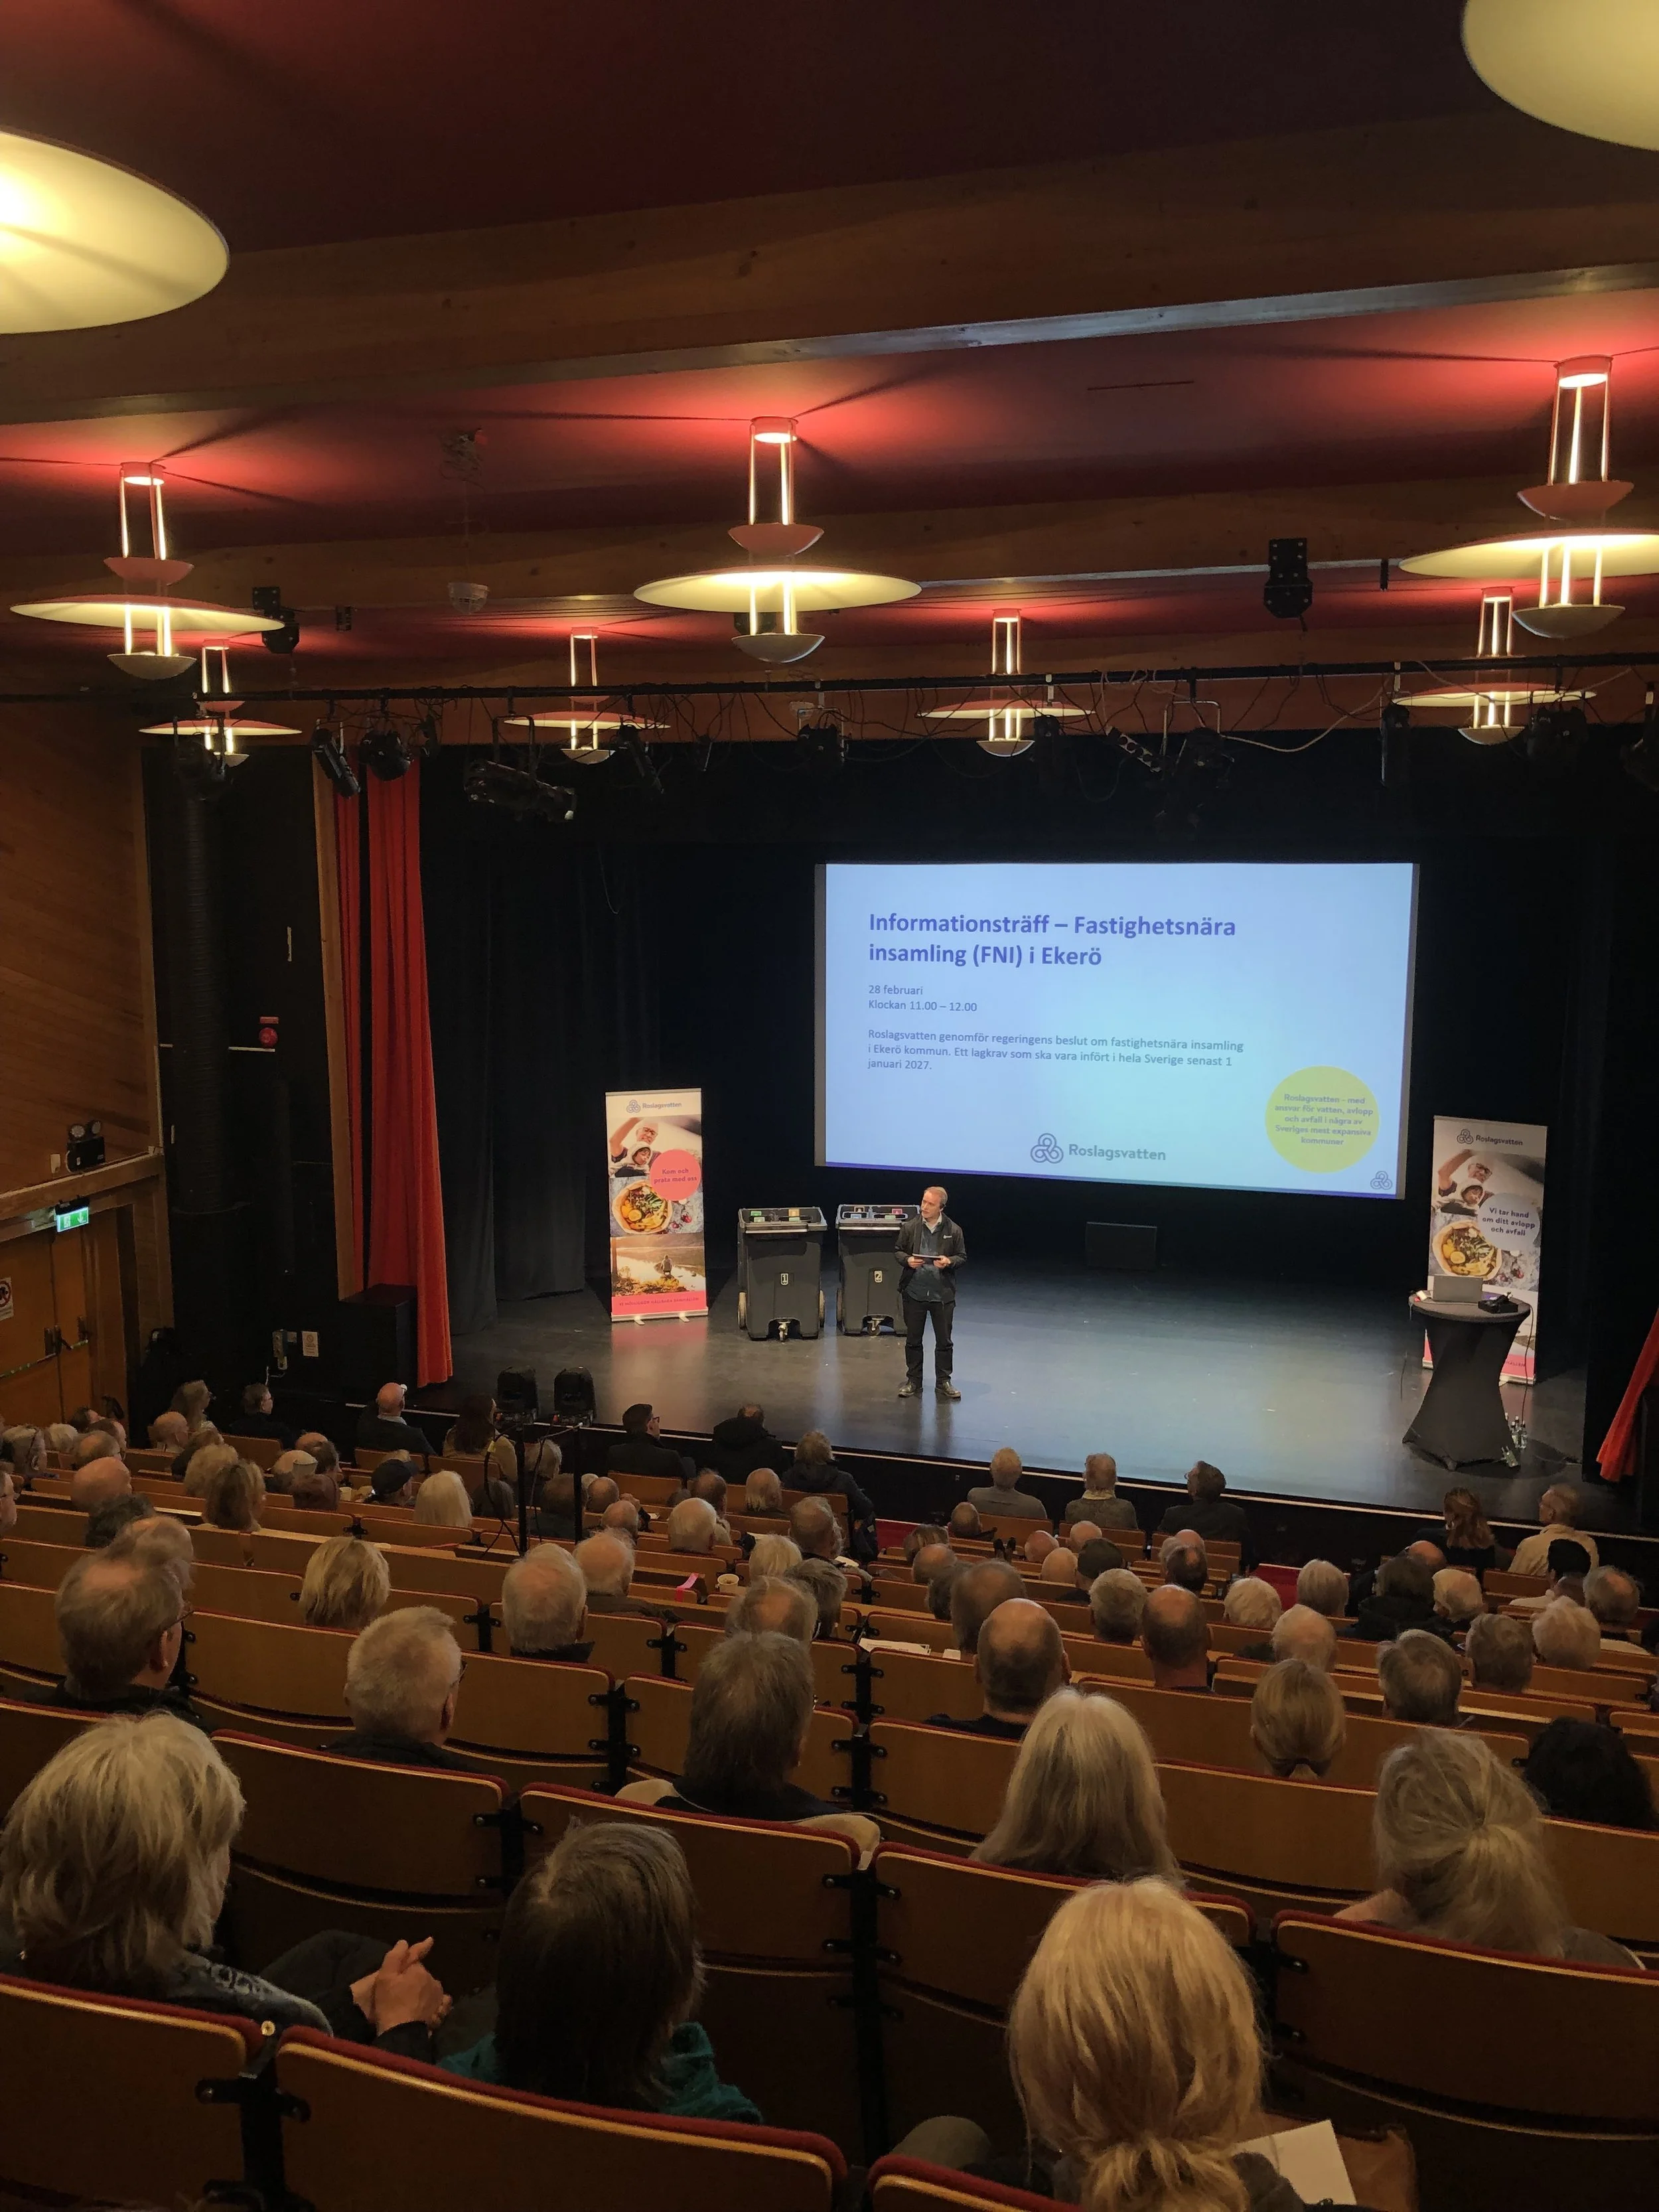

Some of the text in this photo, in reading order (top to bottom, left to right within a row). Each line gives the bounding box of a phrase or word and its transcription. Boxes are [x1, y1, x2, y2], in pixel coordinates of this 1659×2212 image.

[870, 913, 1050, 933] Informationsträff
[1074, 916, 1236, 938] Fastighetsnära
[869, 943, 1102, 968] insamling (FNI) i Ekerö
[868, 985, 923, 995] 28 februari
[868, 999, 906, 1010] Klockan
[909, 1001, 937, 1011] 11.00
[949, 1002, 977, 1011] 12.00
[868, 1029, 1244, 1053] Roslagsvatten genomför regeringens beslut om fastighetsnära insamling
[868, 1044, 871, 1053] i
[873, 1044, 902, 1054] Ekerö
[904, 1045, 952, 1056] kommun.
[954, 1047, 969, 1057] Ett
[971, 1048, 1007, 1059] lagkrav
[1035, 1050, 1052, 1060] ska
[1054, 1053, 1077, 1061] vara
[1080, 1051, 1110, 1062] infört
[1112, 1053, 1116, 1062] i
[1119, 1053, 1141, 1063] hela
[1144, 1054, 1184, 1066] Sverige
[1187, 1056, 1222, 1066] senast
[1226, 1057, 1232, 1066] 1
[867, 1058, 932, 1070] januari 2027.
[1284, 1094, 1339, 1104] Roslagsvatten
[1346, 1108, 1374, 1118] avlopp
[1301, 1115, 1323, 1124] avfall
[1329, 1116, 1352, 1126] några
[1275, 1125, 1309, 1134] Sveriges
[1301, 1136, 1344, 1145] kommuner
[1476, 1134, 1523, 1145] Roslagsvatten
[1068, 1143, 1166, 1161] Roslagsvatten
[1510, 1220, 1535, 1229] avlopp
